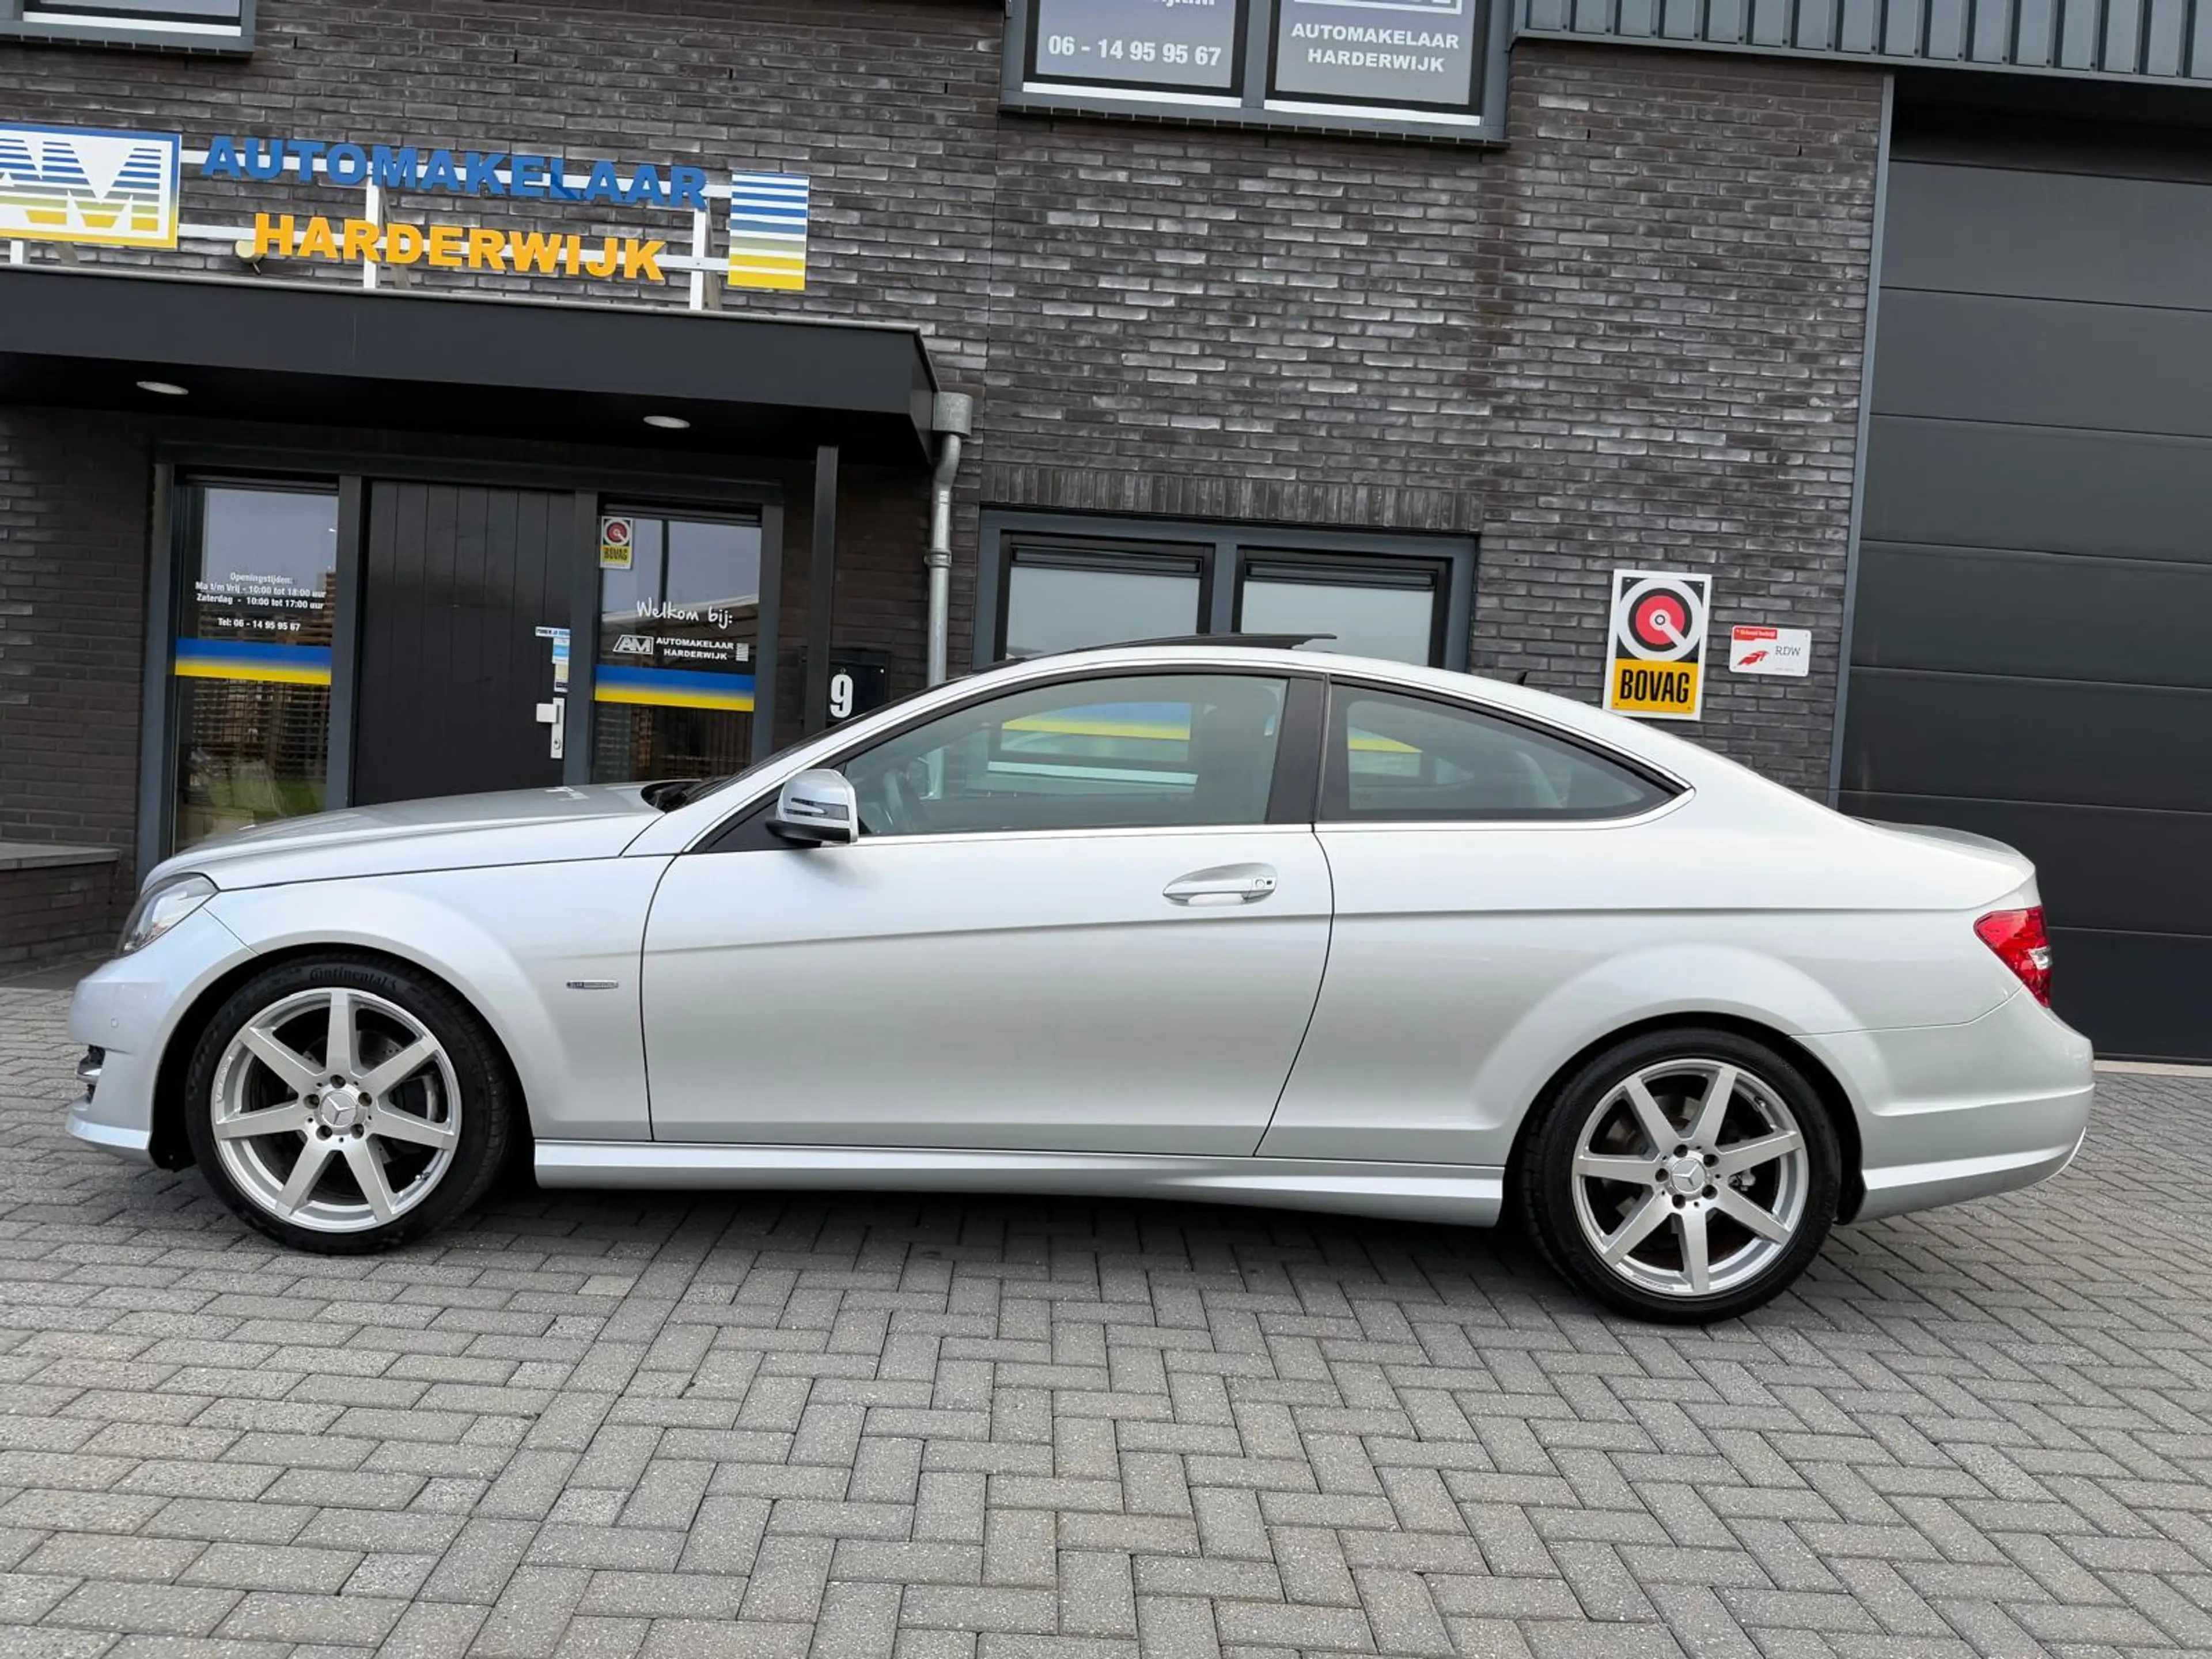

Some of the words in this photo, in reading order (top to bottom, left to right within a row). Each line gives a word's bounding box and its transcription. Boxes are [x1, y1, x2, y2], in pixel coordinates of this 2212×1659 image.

[1291, 23, 1459, 50] AUTOMAKELAAR
[1048, 35, 1075, 56] 06
[1098, 39, 1123, 59] 14
[1130, 41, 1156, 62] 95
[1162, 43, 1188, 65] 95
[1195, 46, 1221, 66] 67
[1308, 48, 1445, 73] HARDERWIJK
[202, 135, 708, 211] AUTOMAKELAAR
[254, 213, 667, 281] HARDERWIJK
[195, 581, 208, 590] Ma
[249, 585, 272, 594] 10:00
[274, 587, 286, 596] tot
[196, 593, 233, 605] Zaterdag
[247, 597, 270, 607] 10:00
[271, 599, 283, 607] tot
[285, 600, 308, 609] 17:00
[218, 618, 232, 627] Tel:
[233, 619, 244, 627] 06
[252, 620, 262, 628] 14
[637, 597, 699, 622] Welkom
[708, 605, 733, 630] bij:
[618, 636, 650, 653] AM
[656, 637, 734, 650] AUTOMAKELAAR
[664, 648, 727, 660] HARDERWIJK
[1775, 645, 1801, 656] RDW
[830, 673, 853, 718] 9
[1620, 669, 1690, 704] BOVAG
